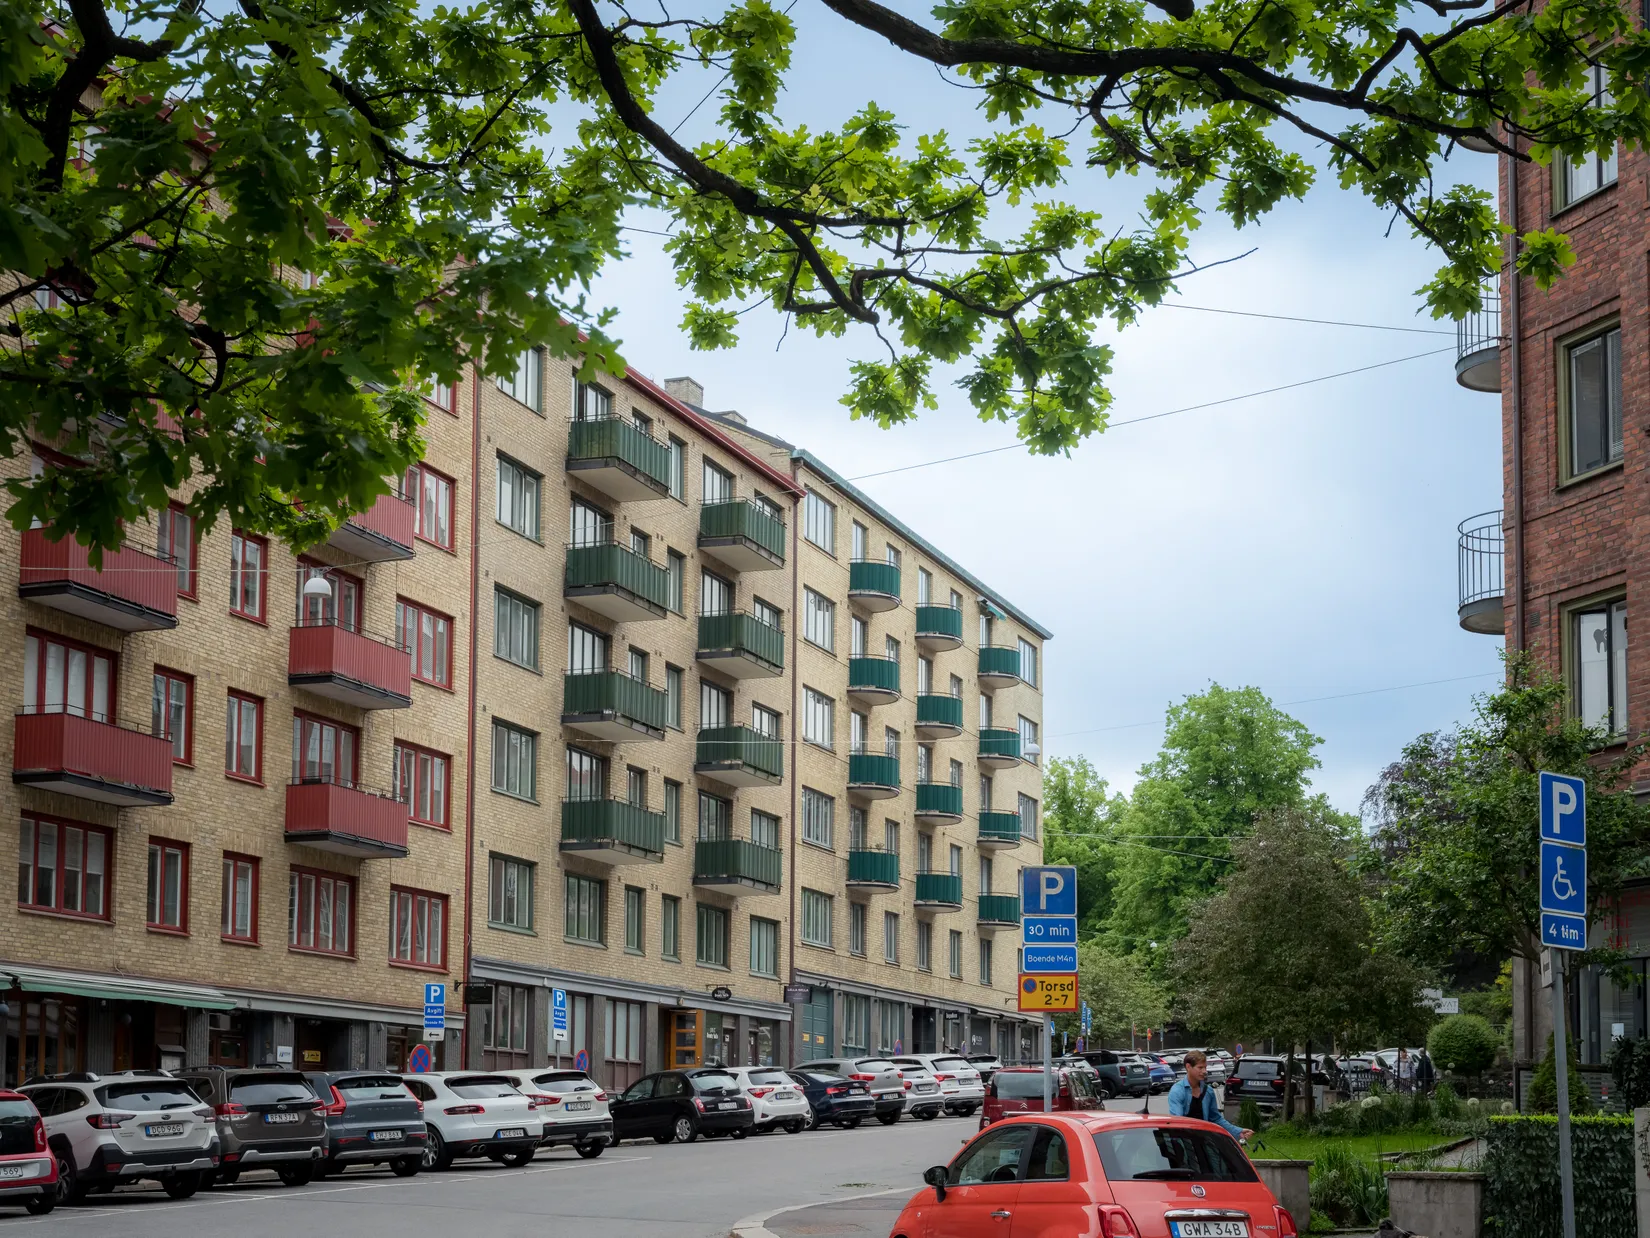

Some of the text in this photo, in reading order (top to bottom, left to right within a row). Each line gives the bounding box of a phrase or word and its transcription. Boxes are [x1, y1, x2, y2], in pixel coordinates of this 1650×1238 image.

[1552, 781, 1577, 834] P
[1039, 871, 1065, 910] P
[1028, 924, 1070, 936] 30 min
[1549, 923, 1579, 941] 4 tim
[1027, 954, 1074, 963] Boende M4n
[1039, 980, 1074, 992] Torsd
[430, 985, 441, 1003] P
[556, 991, 564, 1006] P
[1044, 995, 1069, 1006] 2-7
[3, 1167, 18, 1176] 569
[1183, 1223, 1242, 1236] GWA 34B
